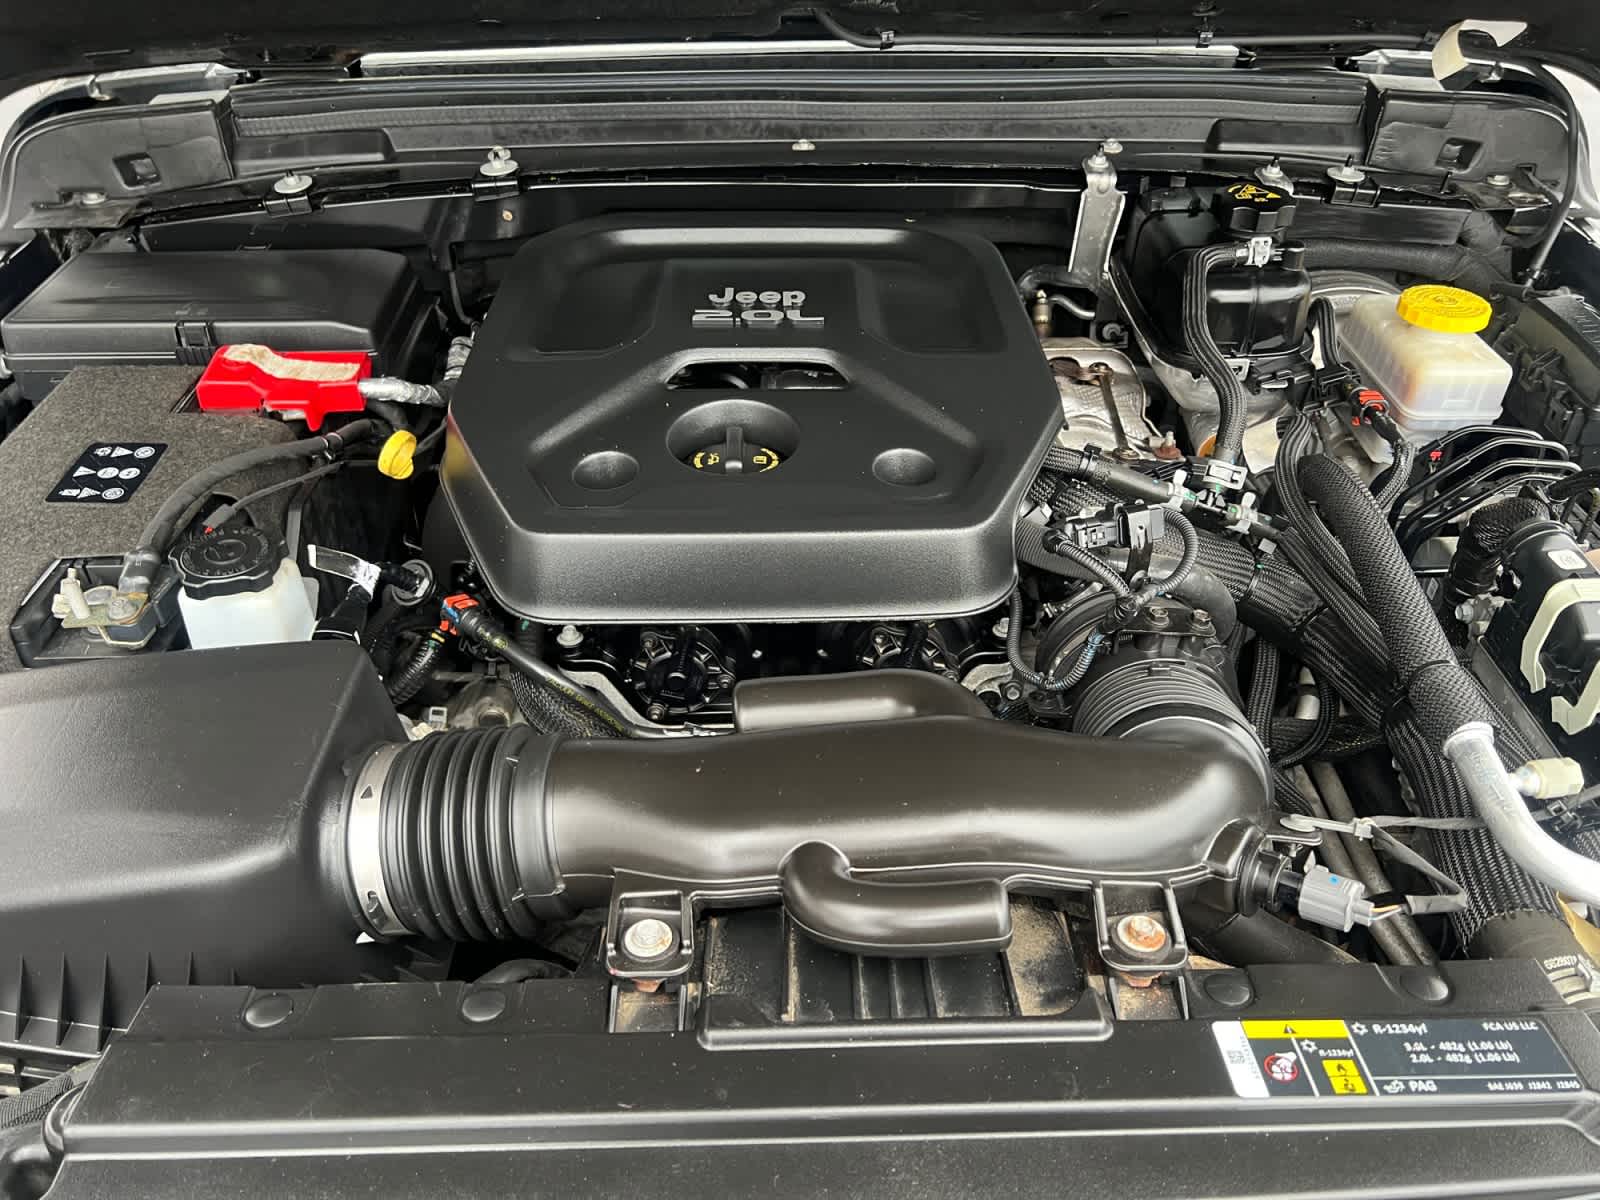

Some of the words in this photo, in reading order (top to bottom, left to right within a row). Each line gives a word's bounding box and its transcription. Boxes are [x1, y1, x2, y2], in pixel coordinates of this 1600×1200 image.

[708, 287, 806, 307] Jeep
[692, 309, 824, 328] 2.0L
[1504, 1021, 1520, 1031] US
[1520, 1020, 1539, 1031] LLC
[1409, 1080, 1438, 1092] PAG
